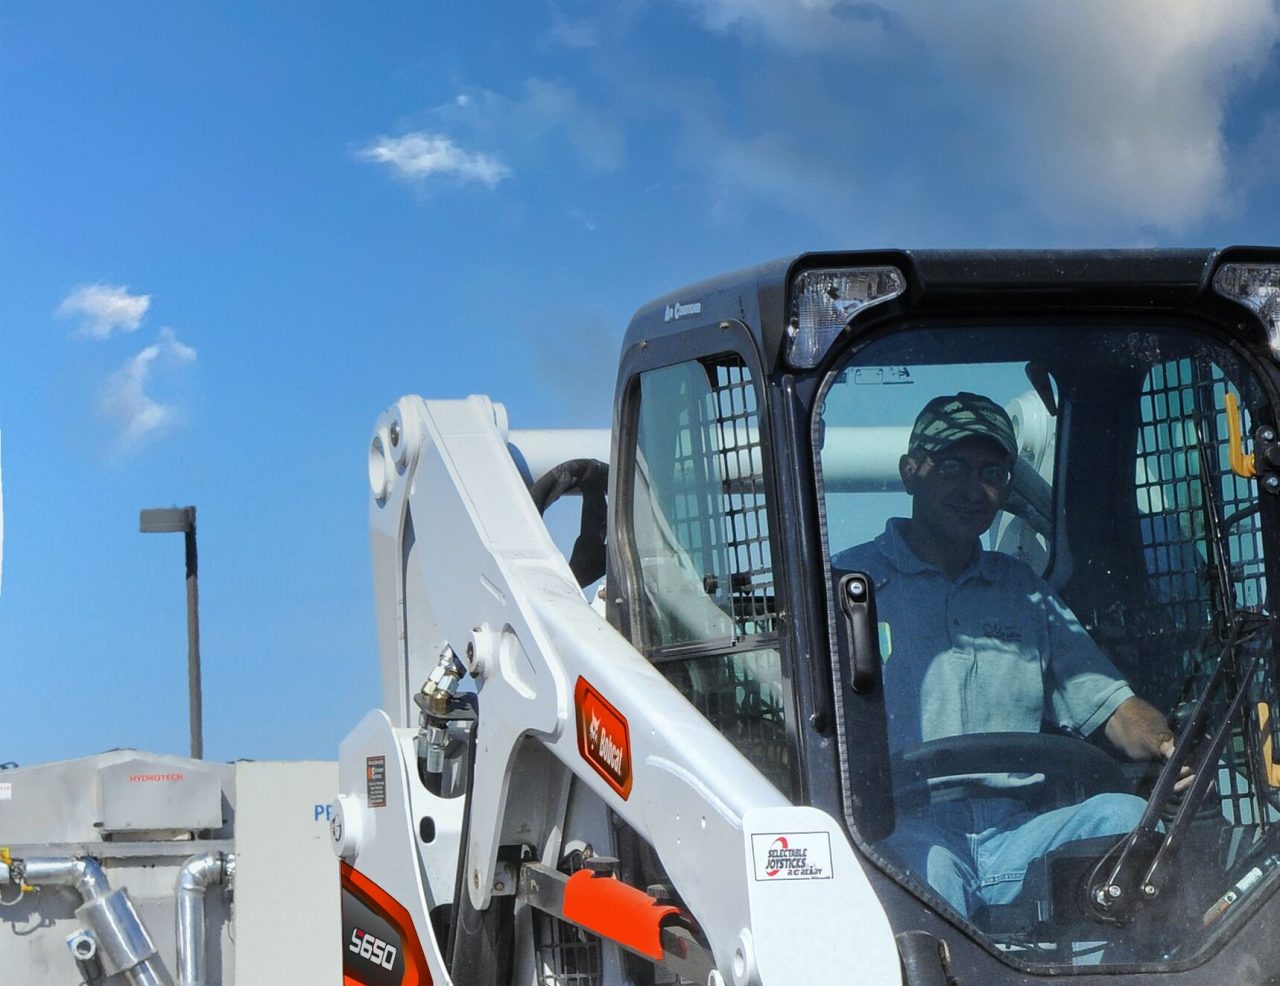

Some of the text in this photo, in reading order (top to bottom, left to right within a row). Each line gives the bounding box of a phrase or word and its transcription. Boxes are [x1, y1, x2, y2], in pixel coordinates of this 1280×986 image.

[599, 727, 624, 776] Bobcat
[129, 773, 184, 782] HYDROTECH
[768, 848, 807, 858] SELECTABLE
[766, 858, 807, 869] JOYSTICKS
[349, 928, 397, 971] S650
